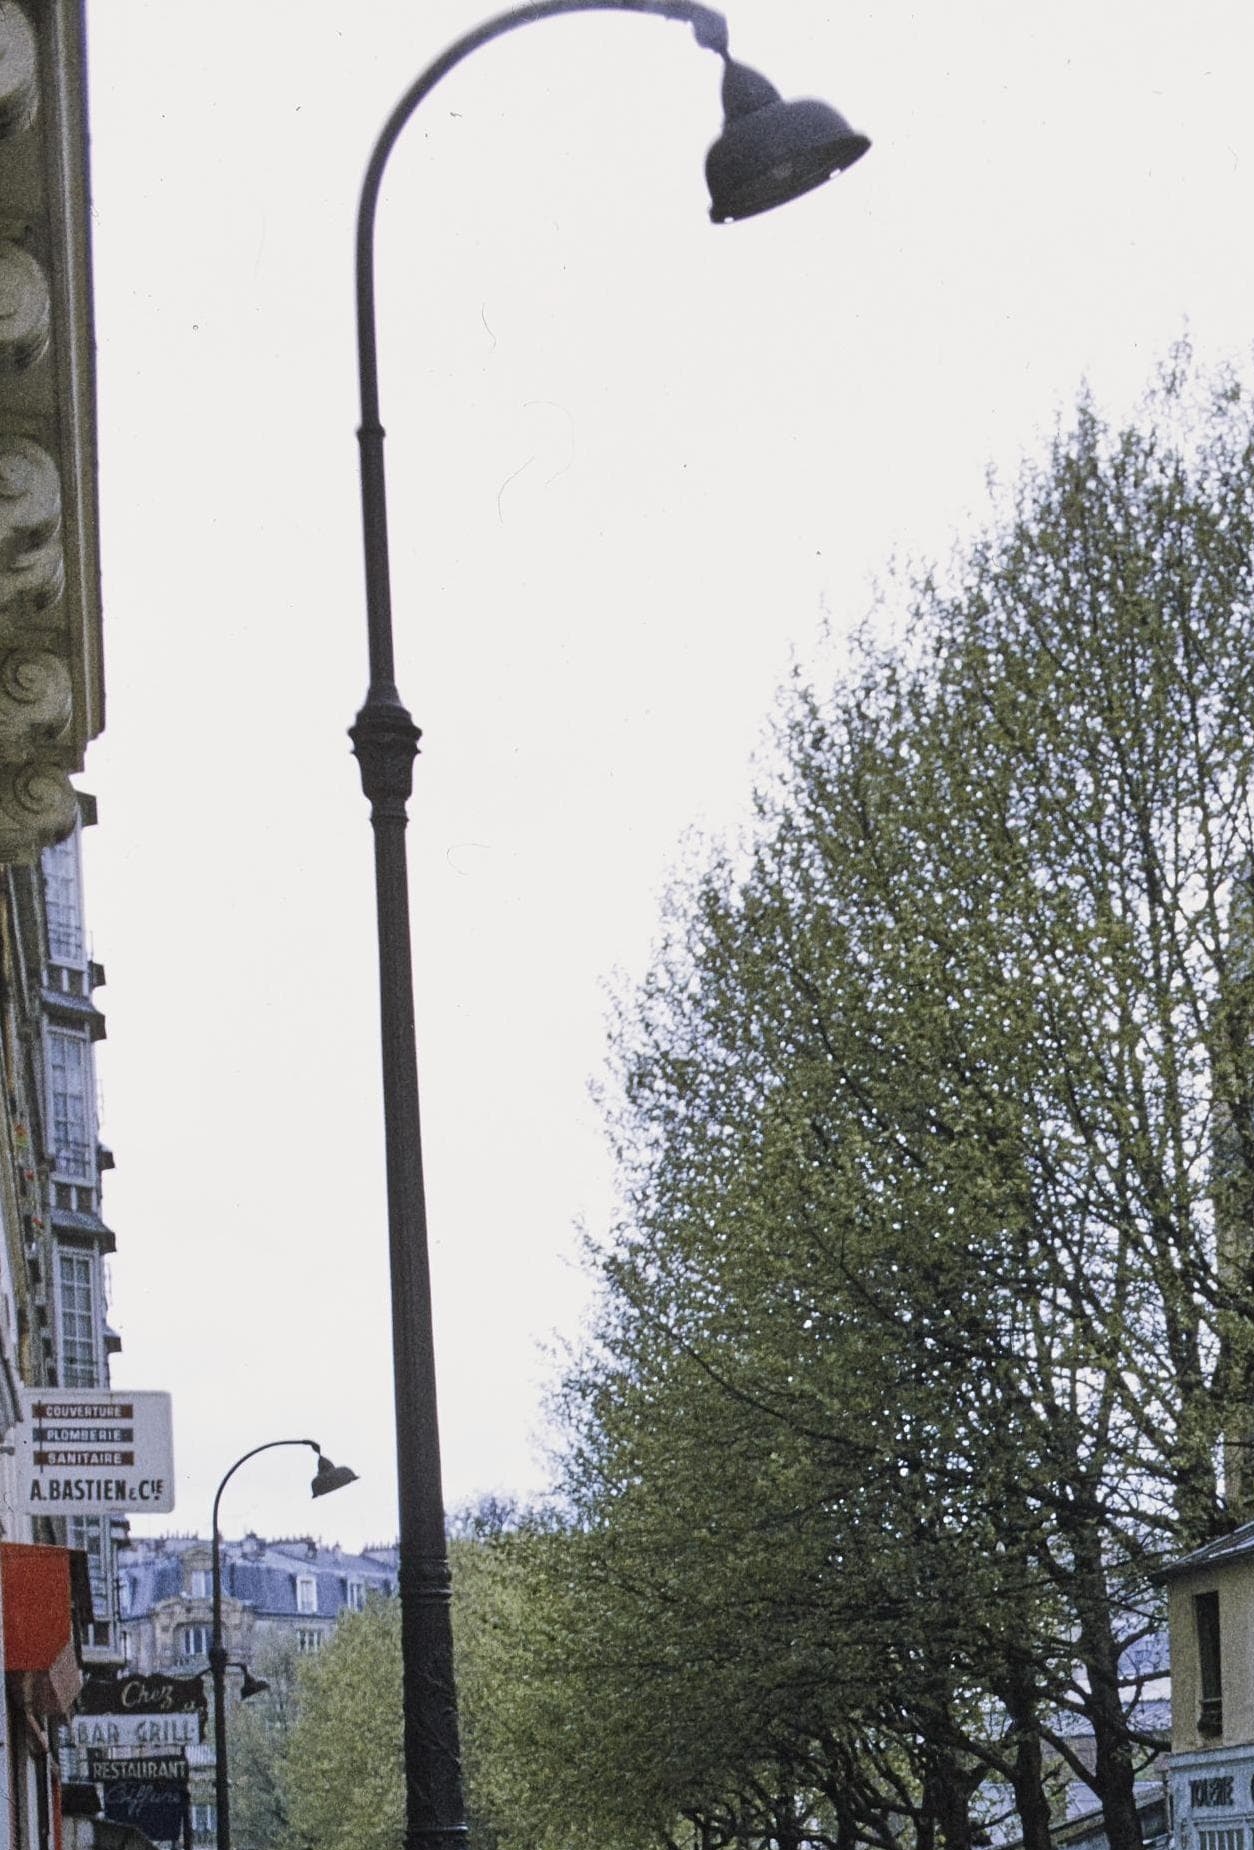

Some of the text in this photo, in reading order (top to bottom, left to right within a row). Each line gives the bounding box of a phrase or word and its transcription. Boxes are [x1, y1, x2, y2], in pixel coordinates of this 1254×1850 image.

[46, 1405, 122, 1417] COUVERTURE
[46, 1428, 122, 1441] PLOMBERIE
[47, 1452, 123, 1464] SANITAIRE
[121, 1680, 174, 1709] Chez
[78, 1719, 194, 1744] BAR GRILL
[92, 1758, 187, 1780] RESTAURANT
